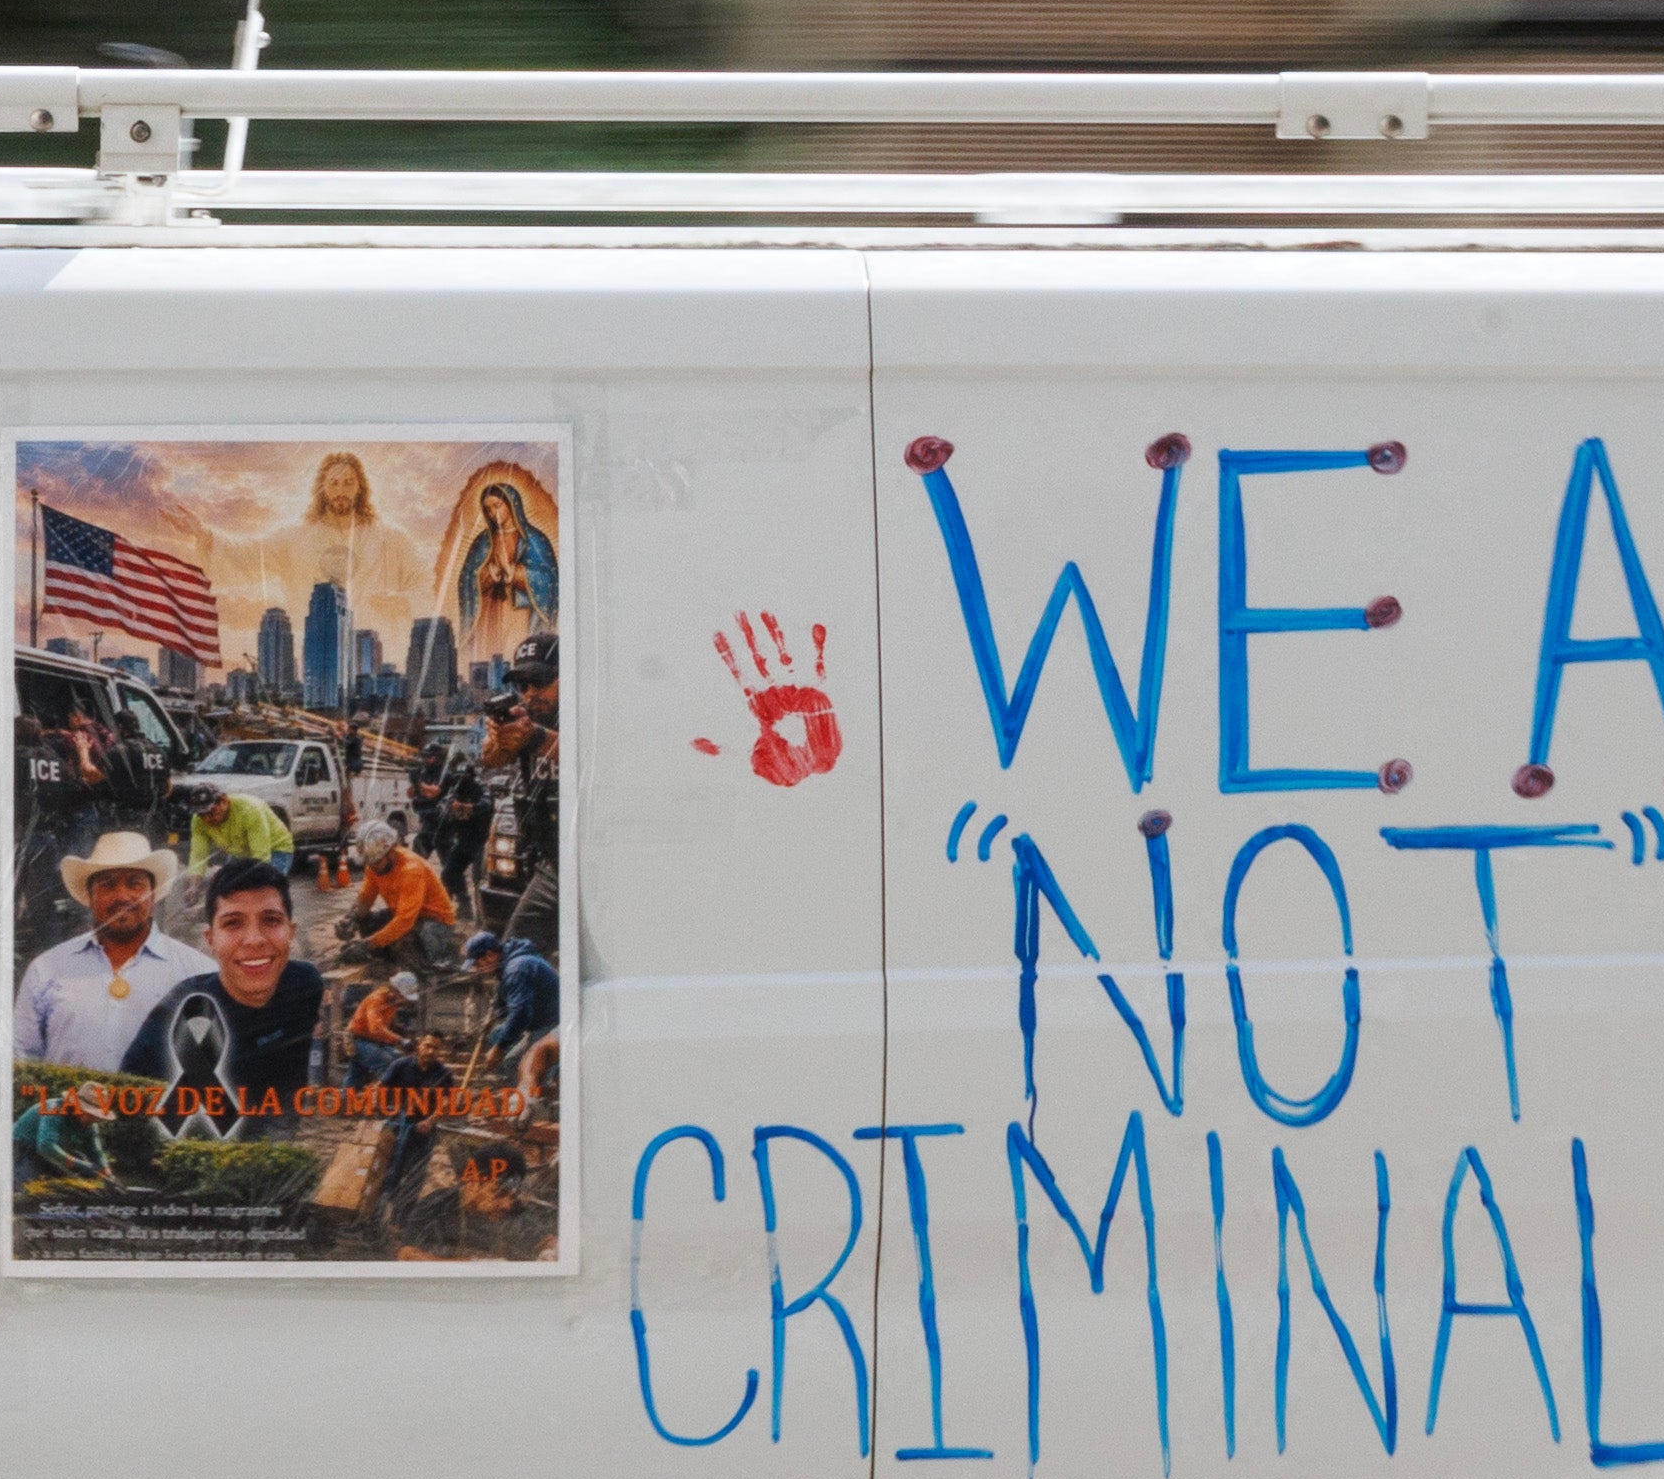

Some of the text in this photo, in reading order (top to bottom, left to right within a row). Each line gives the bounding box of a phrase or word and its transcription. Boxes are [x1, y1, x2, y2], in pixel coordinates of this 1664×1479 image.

[904, 432, 1412, 792] WE
[29, 758, 61, 782] ICE
[142, 753, 164, 770] ICE
[21, 1085, 541, 1117] "LA VOZ DE LA COMUNIDAD"
[461, 1158, 508, 1182] A.P
[141, 1207, 149, 1216] a
[153, 1204, 189, 1216] todos
[192, 1203, 211, 1216] los
[214, 1204, 282, 1219] migrantes
[24, 1228, 48, 1240] que
[52, 1226, 87, 1239] salen
[90, 1226, 123, 1239] cada
[150, 1229, 159, 1239] a
[162, 1226, 216, 1242] trabajar
[219, 1230, 244, 1239] con
[247, 1227, 307, 1241] dignidad
[79, 1248, 132, 1258] familias
